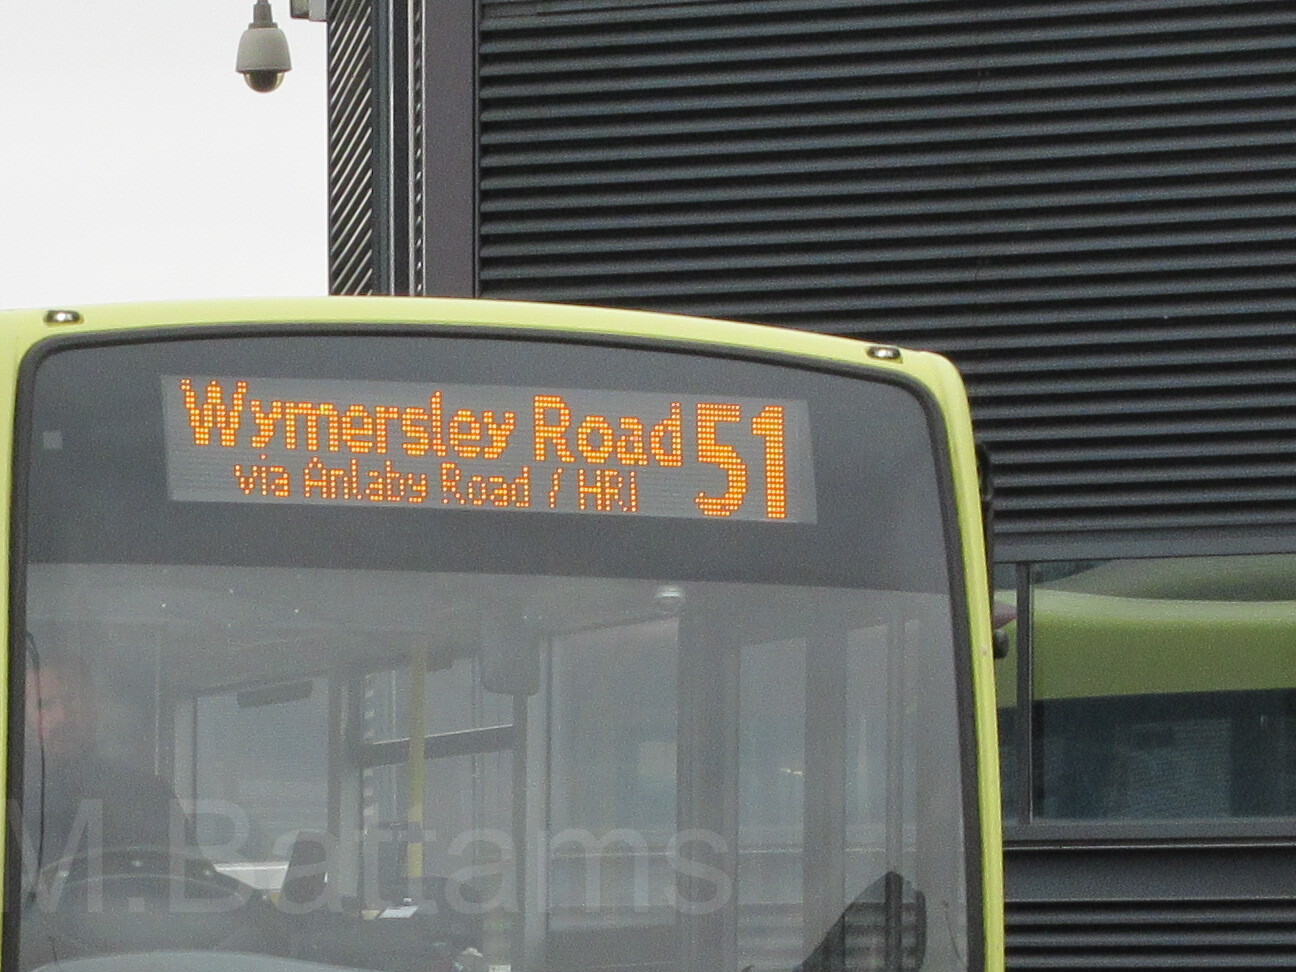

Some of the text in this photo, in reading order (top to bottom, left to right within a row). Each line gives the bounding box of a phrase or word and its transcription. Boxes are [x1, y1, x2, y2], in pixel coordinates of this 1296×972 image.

[180, 378, 683, 467] Wymersley Road
[695, 402, 787, 519] 51
[234, 455, 290, 497] via
[304, 457, 427, 503] Anlaby
[440, 462, 530, 508] Road
[549, 467, 564, 509] /
